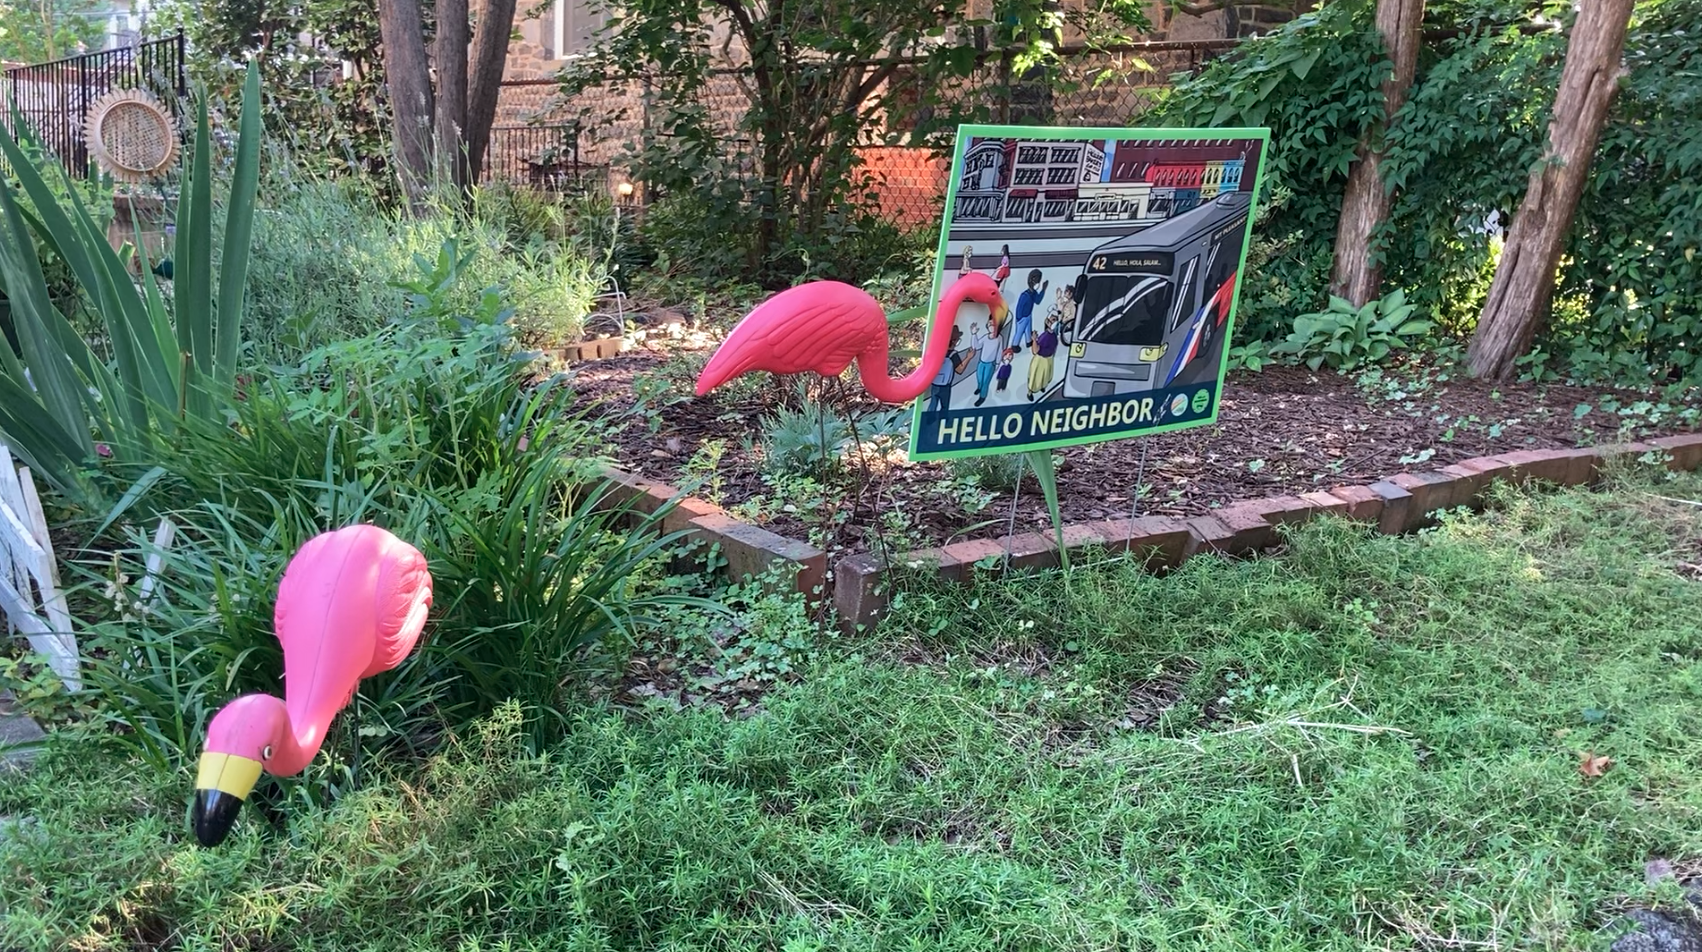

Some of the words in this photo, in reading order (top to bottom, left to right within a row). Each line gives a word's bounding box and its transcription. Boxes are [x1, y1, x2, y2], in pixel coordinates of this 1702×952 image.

[1093, 257, 1107, 270] 42
[937, 412, 1023, 445] HELLO
[1030, 397, 1155, 436] NEIGHBOR
